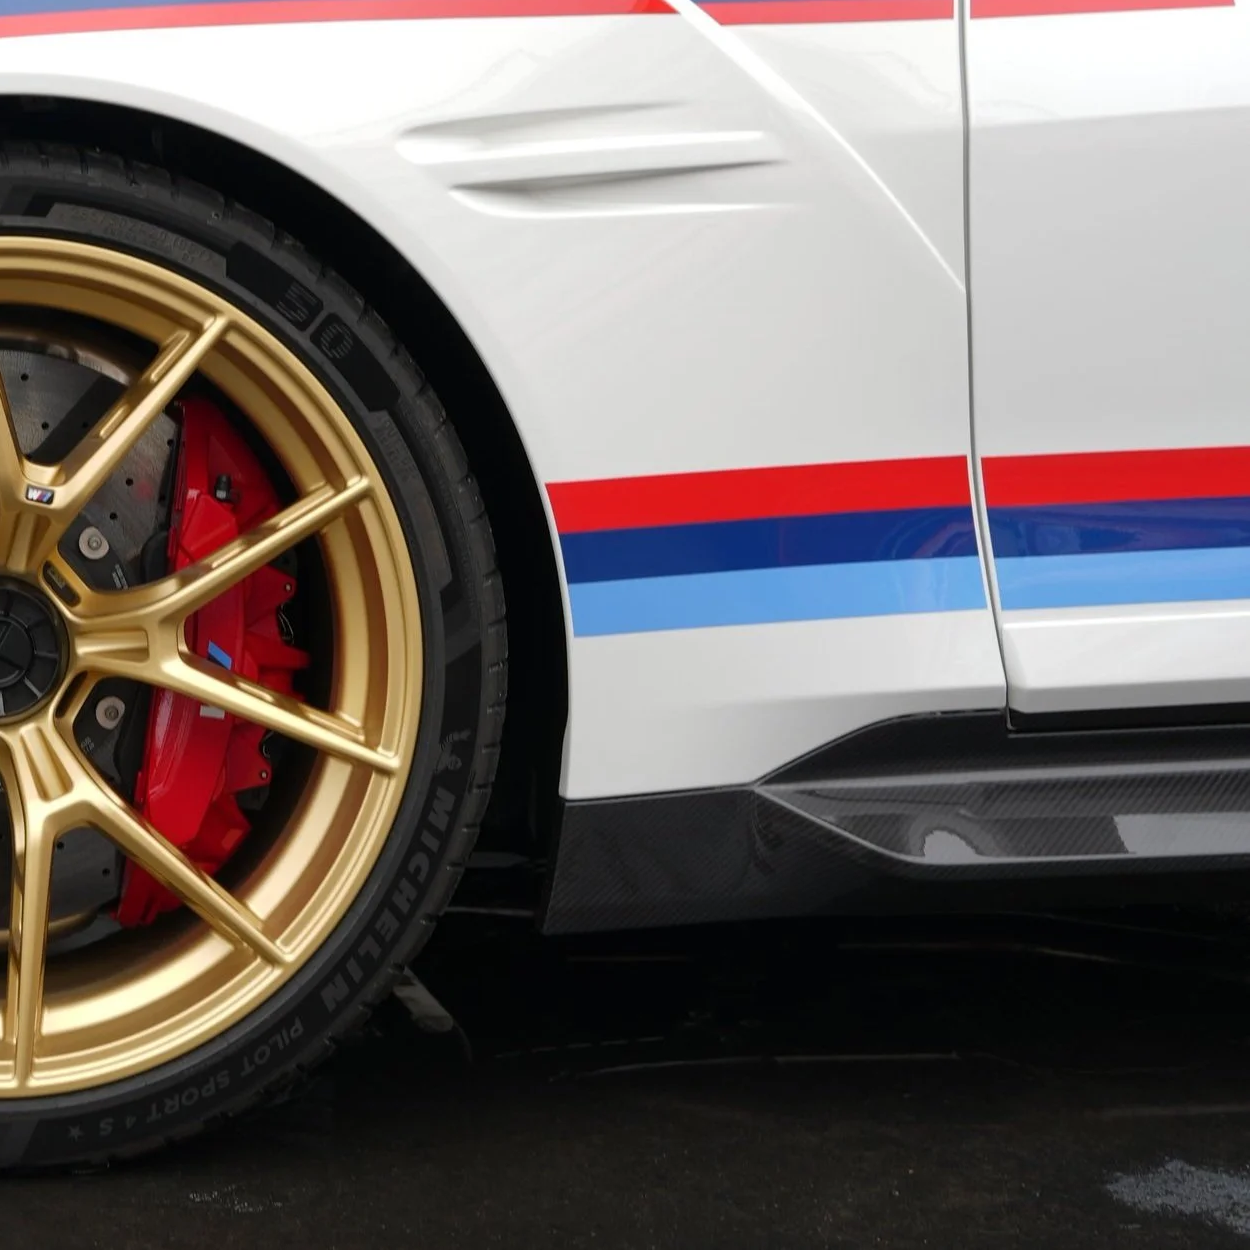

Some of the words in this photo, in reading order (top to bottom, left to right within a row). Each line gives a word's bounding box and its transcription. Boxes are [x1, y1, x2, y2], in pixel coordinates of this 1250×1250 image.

[319, 785, 455, 1013] MICHELIN
[239, 1015, 305, 1078] PILOT
[124, 1114, 137, 1127] 4
[145, 1068, 232, 1123] SPORT
[98, 1116, 115, 1137] S
